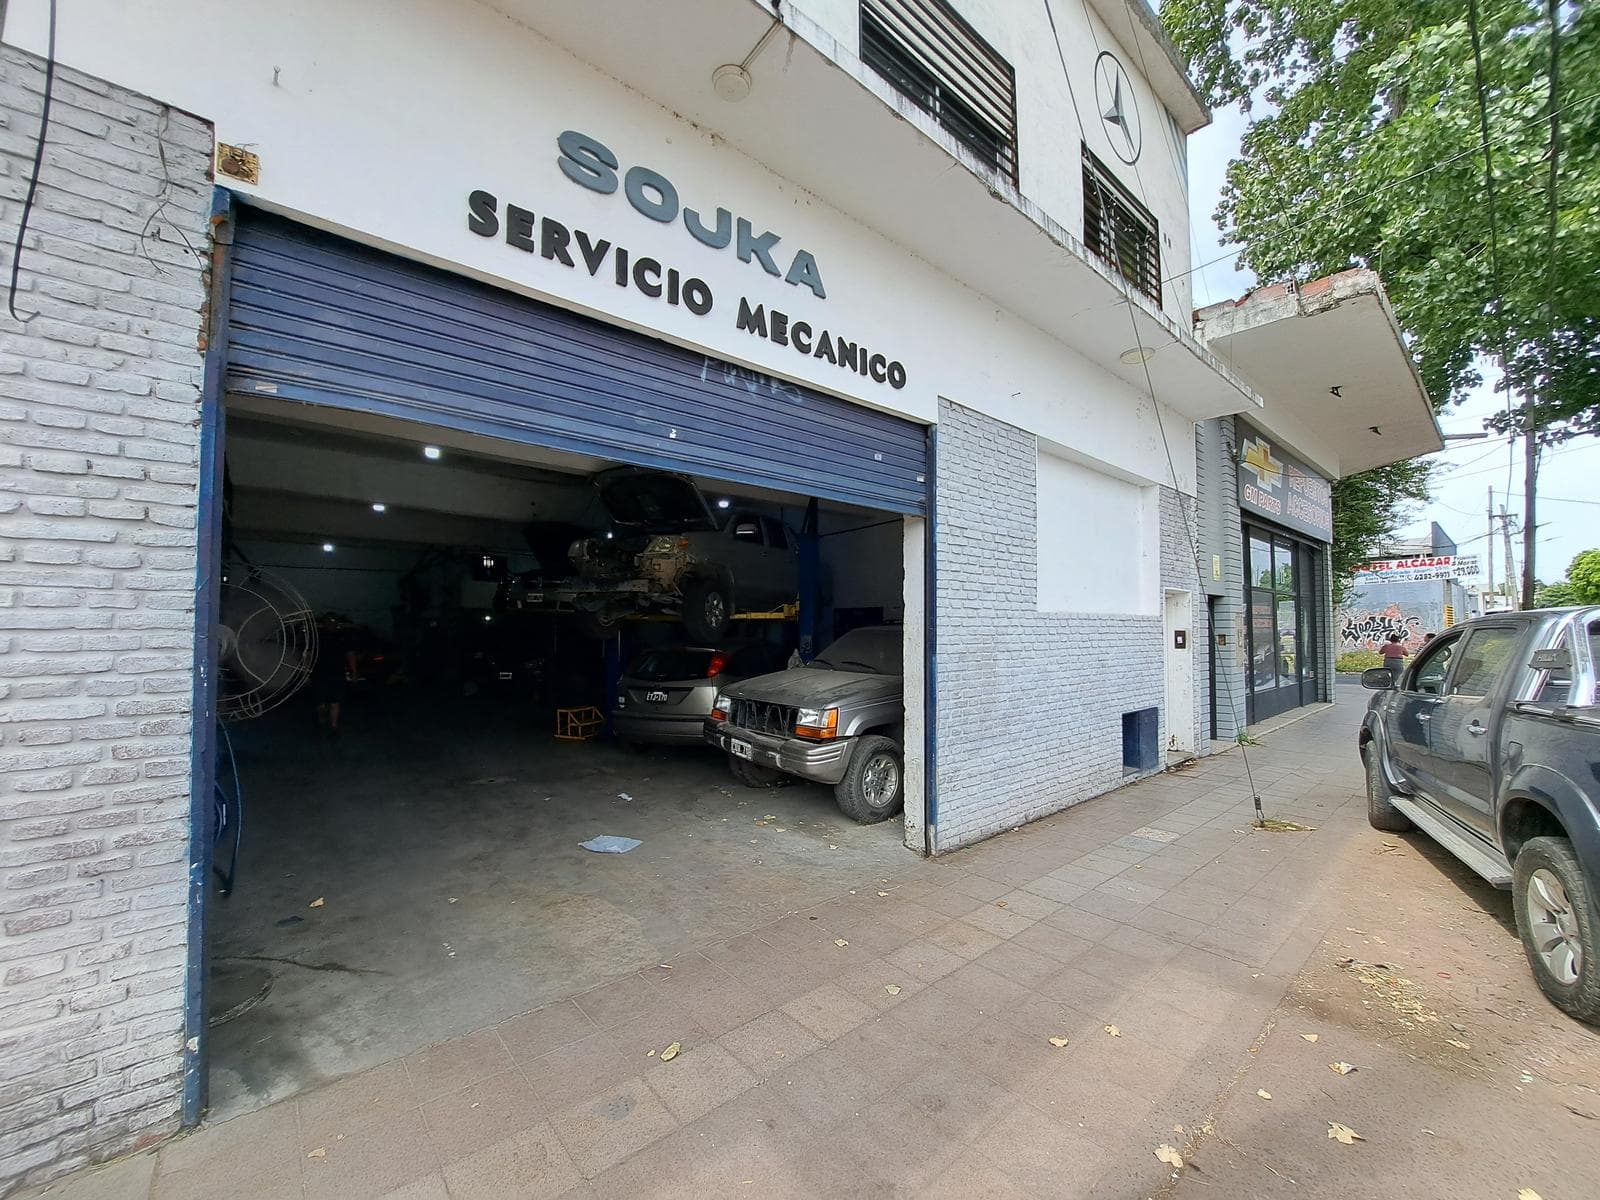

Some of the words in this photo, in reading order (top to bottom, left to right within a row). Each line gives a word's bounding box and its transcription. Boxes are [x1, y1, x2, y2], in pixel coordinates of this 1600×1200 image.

[557, 129, 827, 299] SOJKA
[468, 189, 713, 316] SERVICIO
[736, 296, 908, 390] MECANICO
[1244, 484, 1258, 505] GM
[1258, 490, 1281, 516] PARTS
[1396, 557, 1451, 570] ALCAZAR
